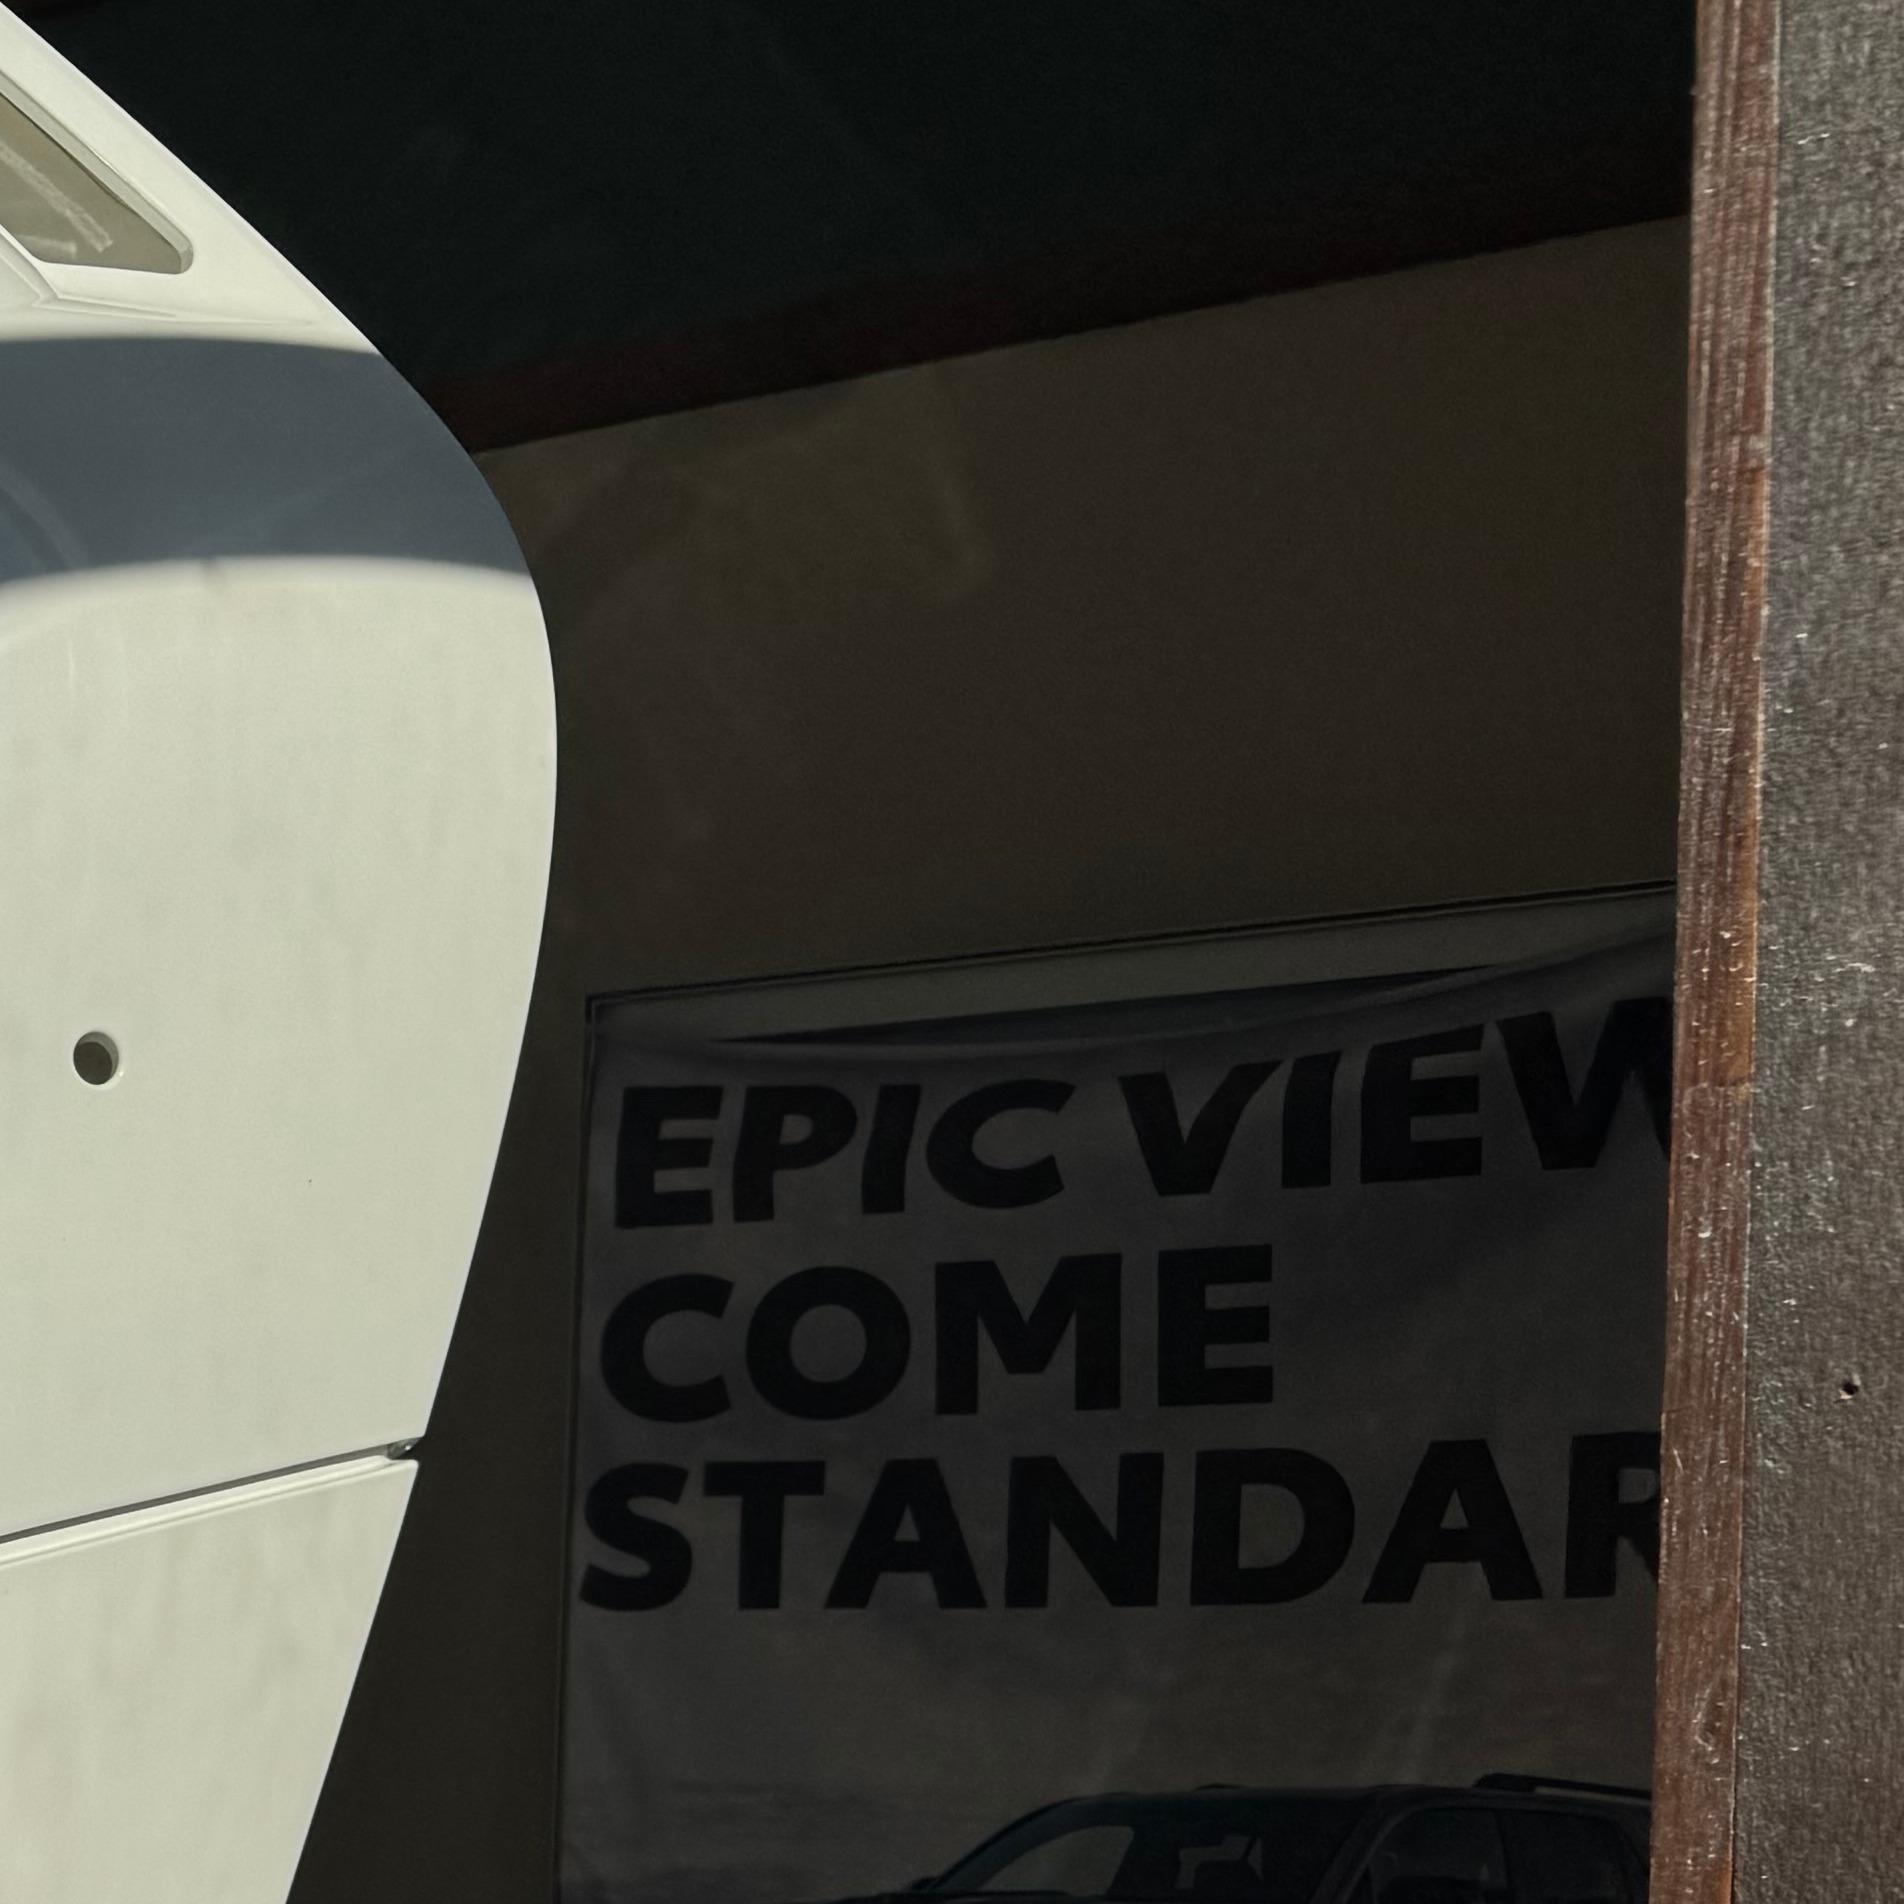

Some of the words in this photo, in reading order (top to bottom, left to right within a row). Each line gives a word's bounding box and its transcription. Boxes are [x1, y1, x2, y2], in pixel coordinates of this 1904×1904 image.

[614, 1078, 1076, 1230] EPIC
[1117, 996, 1674, 1198] VIEW
[600, 1243, 1274, 1425] COME
[578, 1430, 1660, 1611] STANDAR
